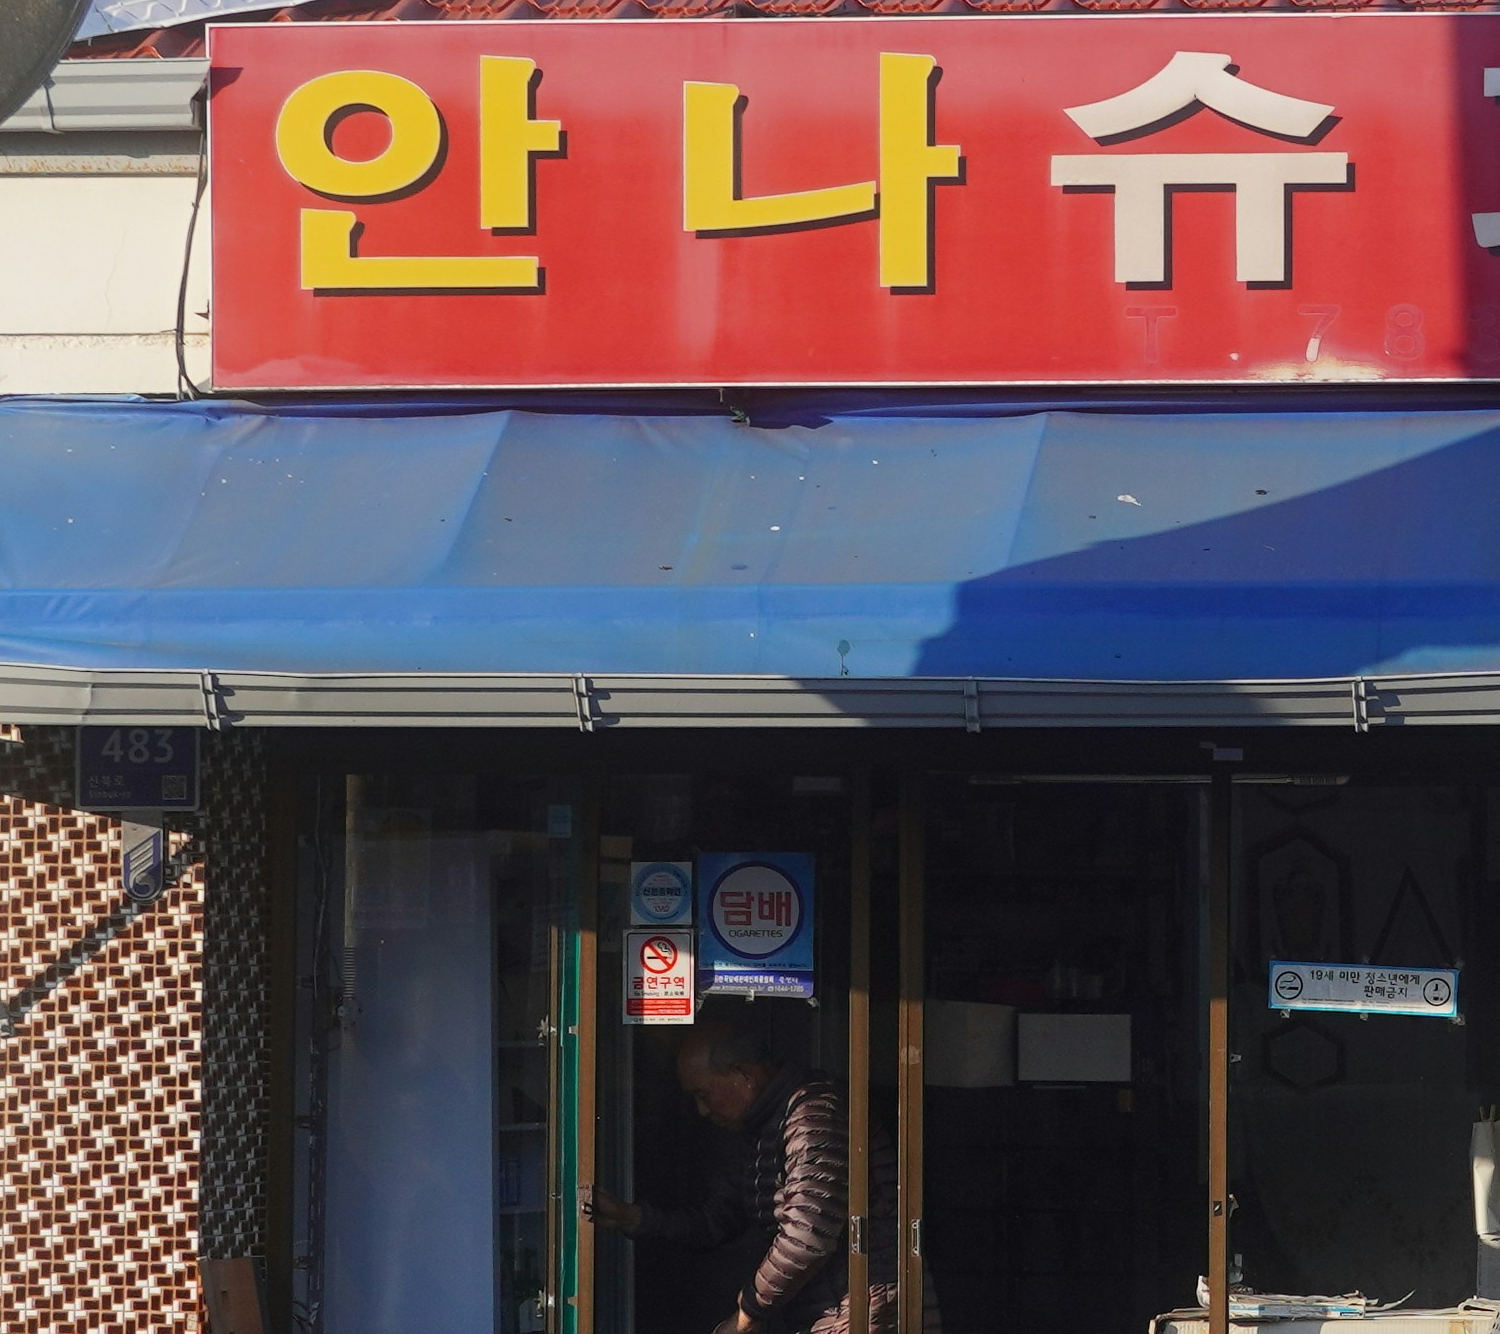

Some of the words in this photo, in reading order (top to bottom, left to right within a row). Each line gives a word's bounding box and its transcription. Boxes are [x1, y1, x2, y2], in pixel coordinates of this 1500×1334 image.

[100, 728, 174, 764] 483
[719, 891, 793, 927] 담배
[728, 929, 783, 938] CIGARETTES
[632, 976, 686, 991] 금연구역
[1309, 969, 1334, 982] 19세
[1339, 970, 1361, 985] 미만
[1363, 985, 1409, 1000] 판매금지
